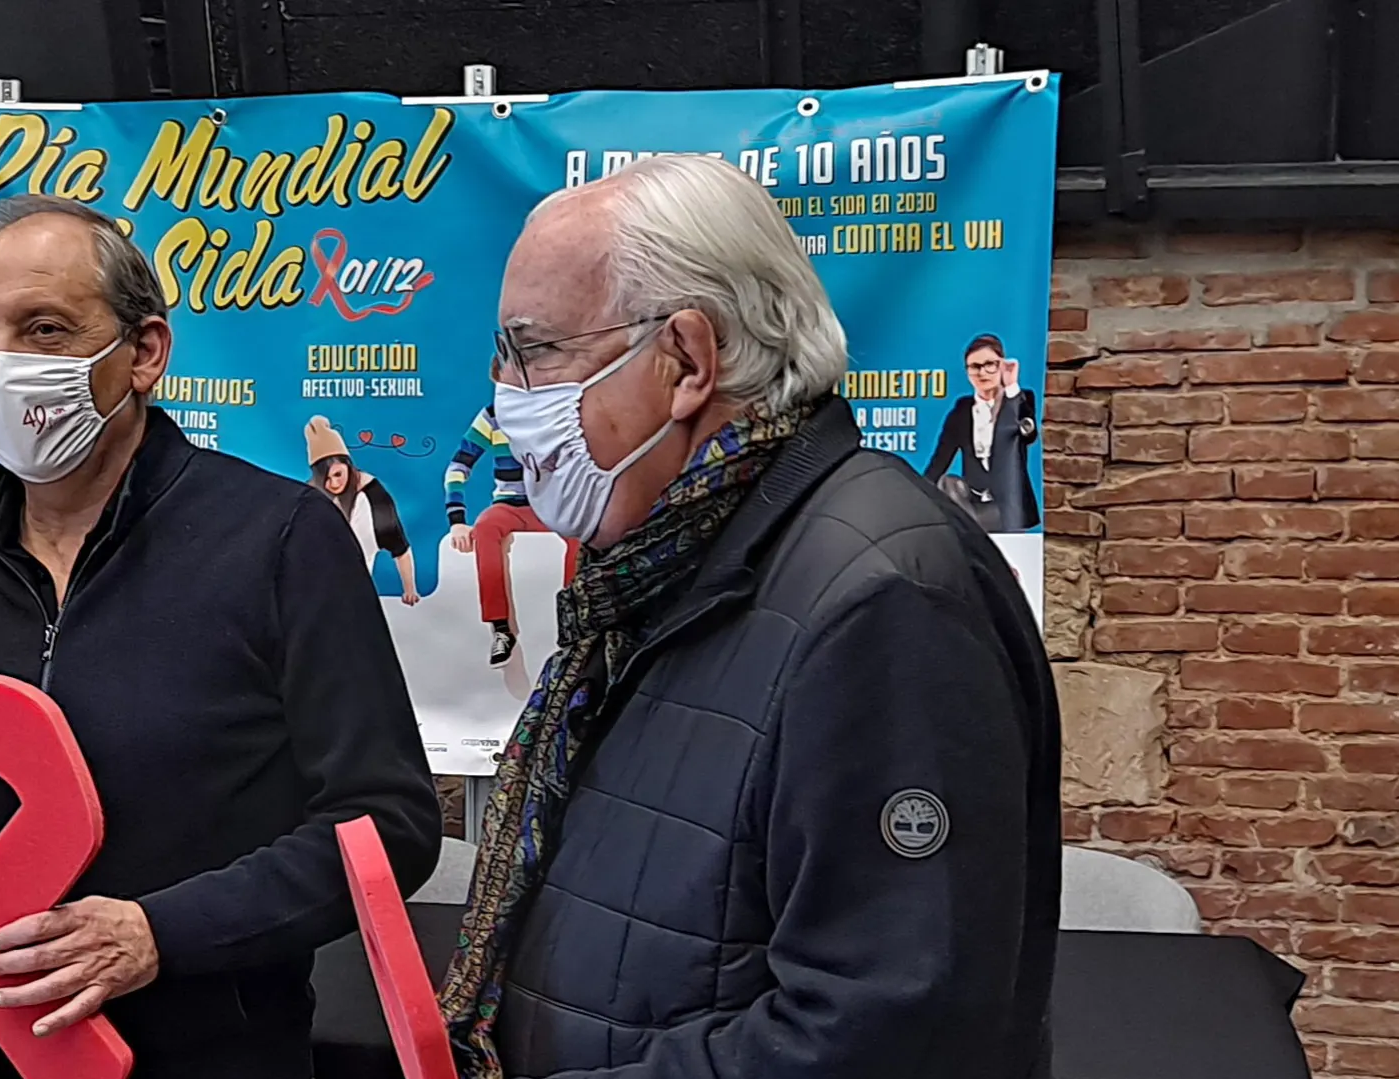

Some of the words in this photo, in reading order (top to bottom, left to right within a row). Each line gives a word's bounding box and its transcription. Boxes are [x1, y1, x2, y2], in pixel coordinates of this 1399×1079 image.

[123, 107, 452, 215] Mundial
[794, 141, 835, 185] 10
[850, 130, 946, 183] AÑOS
[808, 196, 825, 217] EL
[830, 194, 867, 216] SIDA
[871, 193, 891, 214] EN
[896, 191, 937, 213] 2030
[832, 222, 923, 255] CONTRA
[930, 220, 956, 251] EL
[964, 219, 1003, 250] VIH
[153, 216, 305, 312] Sida
[337, 256, 425, 295] 01/12
[307, 339, 418, 372] EDUCACIÓN
[302, 377, 424, 398] AFECTIVO-SEXUAL
[856, 407, 867, 428] A
[872, 406, 917, 428] QUIEN
